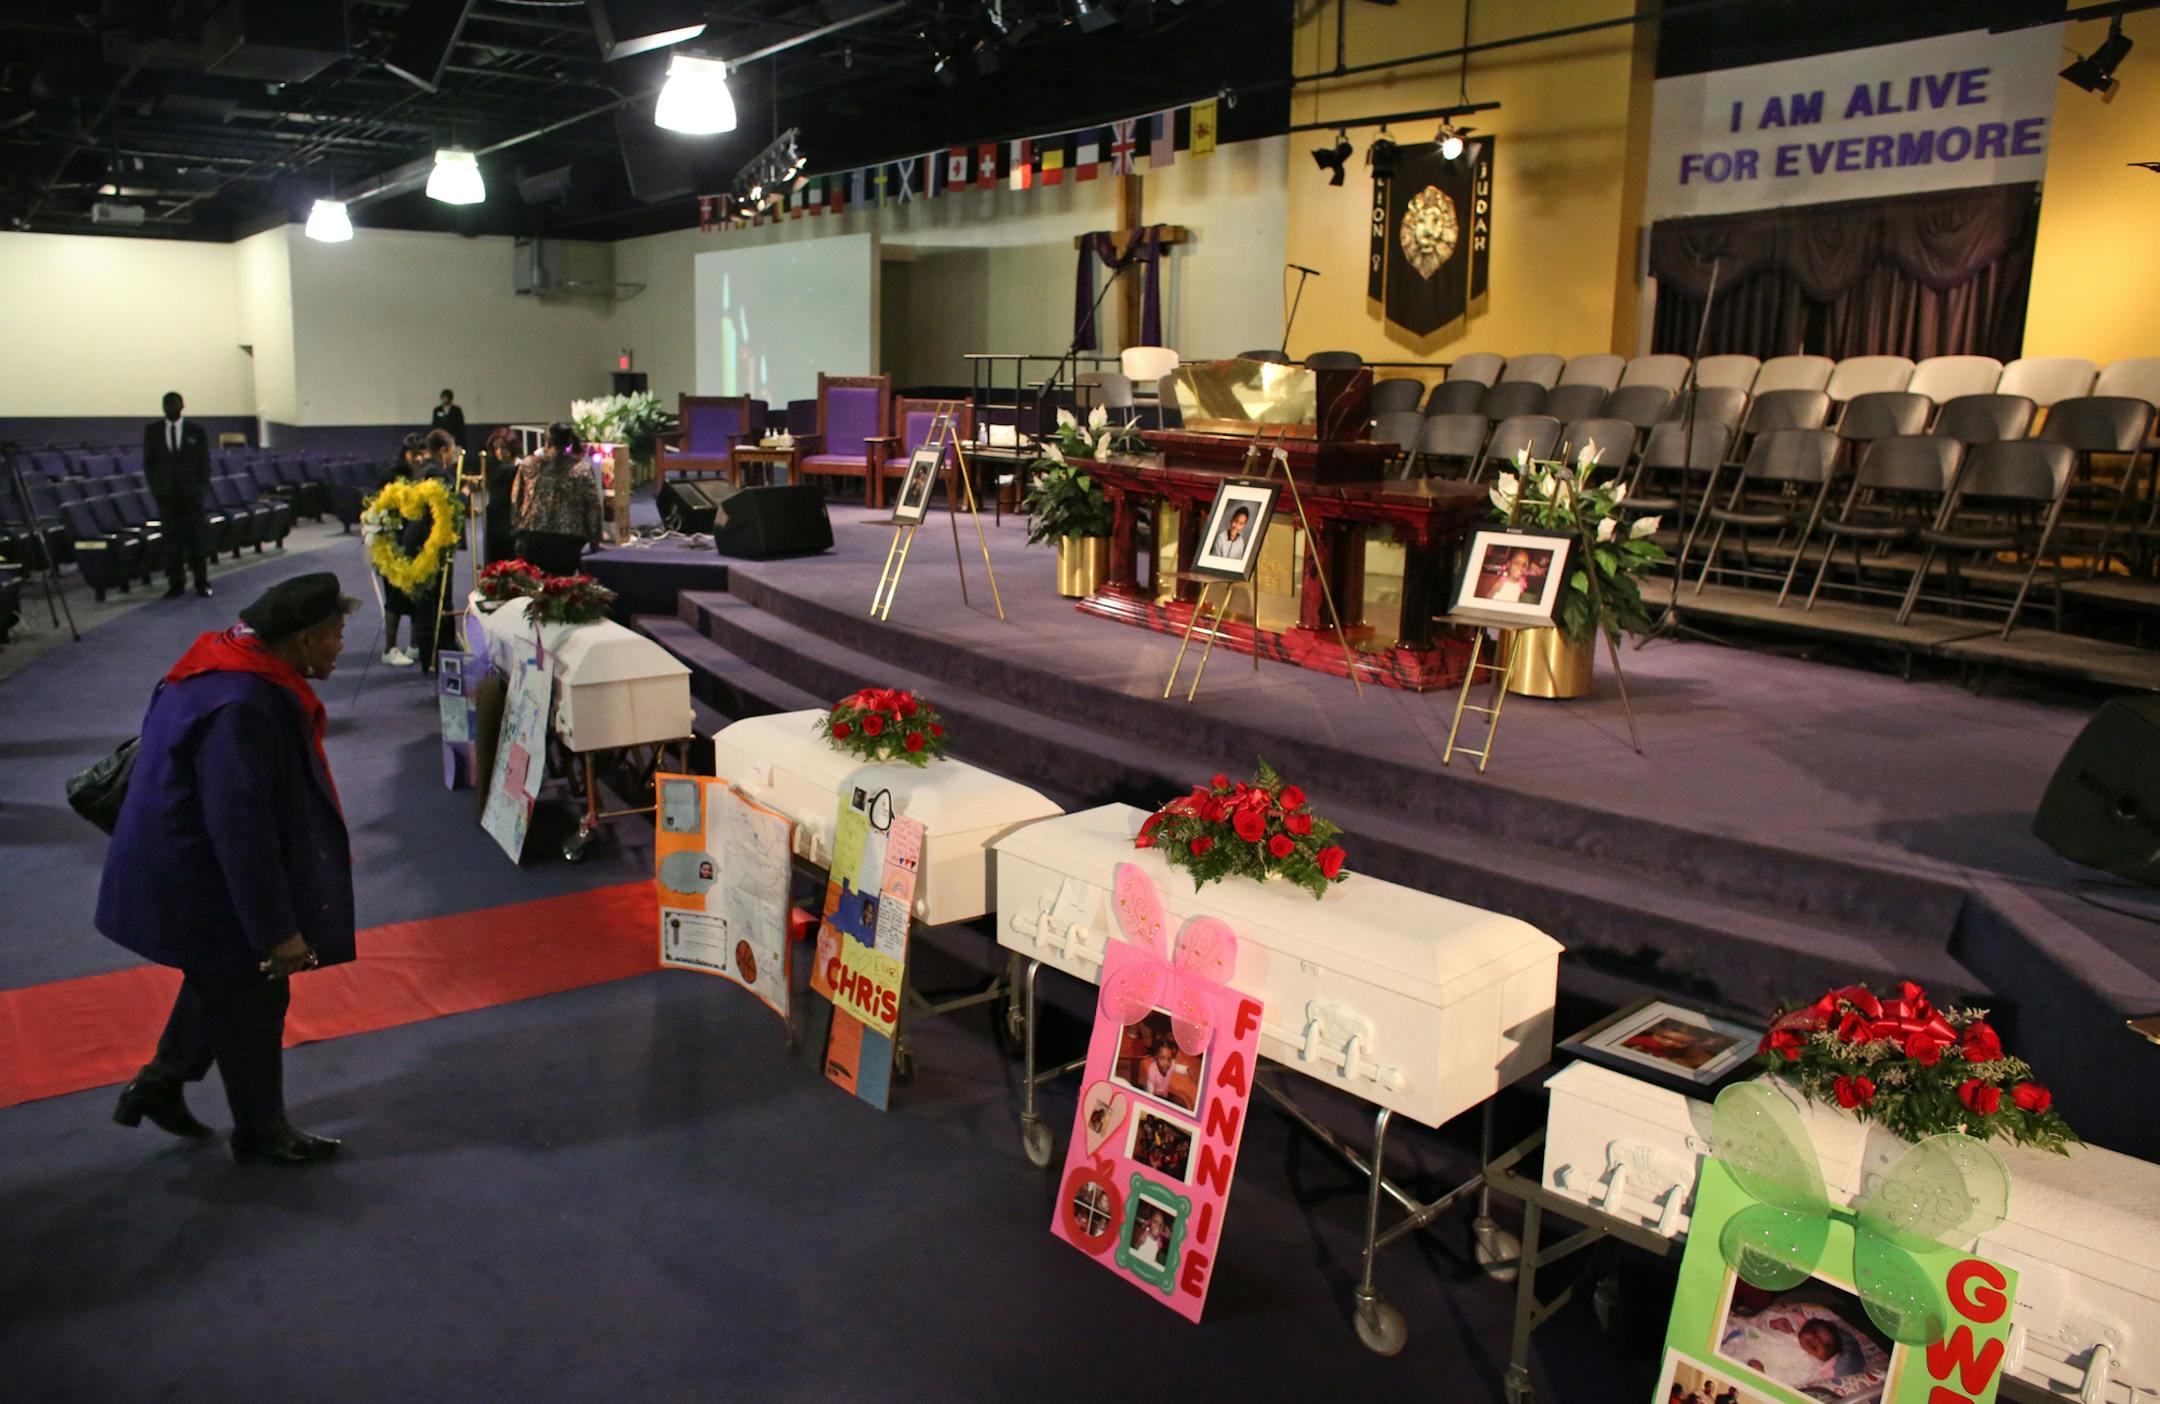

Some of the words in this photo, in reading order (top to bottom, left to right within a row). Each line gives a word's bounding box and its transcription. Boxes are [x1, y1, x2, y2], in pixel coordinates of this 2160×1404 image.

[1731, 102, 1743, 132] I
[1759, 91, 1824, 130] AM
[1845, 67, 1990, 119] ALIVE
[1680, 149, 1757, 185] FOR
[1775, 117, 2045, 178] EVERMORE
[1474, 161, 1489, 251] JUDAH
[1181, 999, 1262, 1298] FANNIE
[1926, 1258, 2008, 1404] GW
